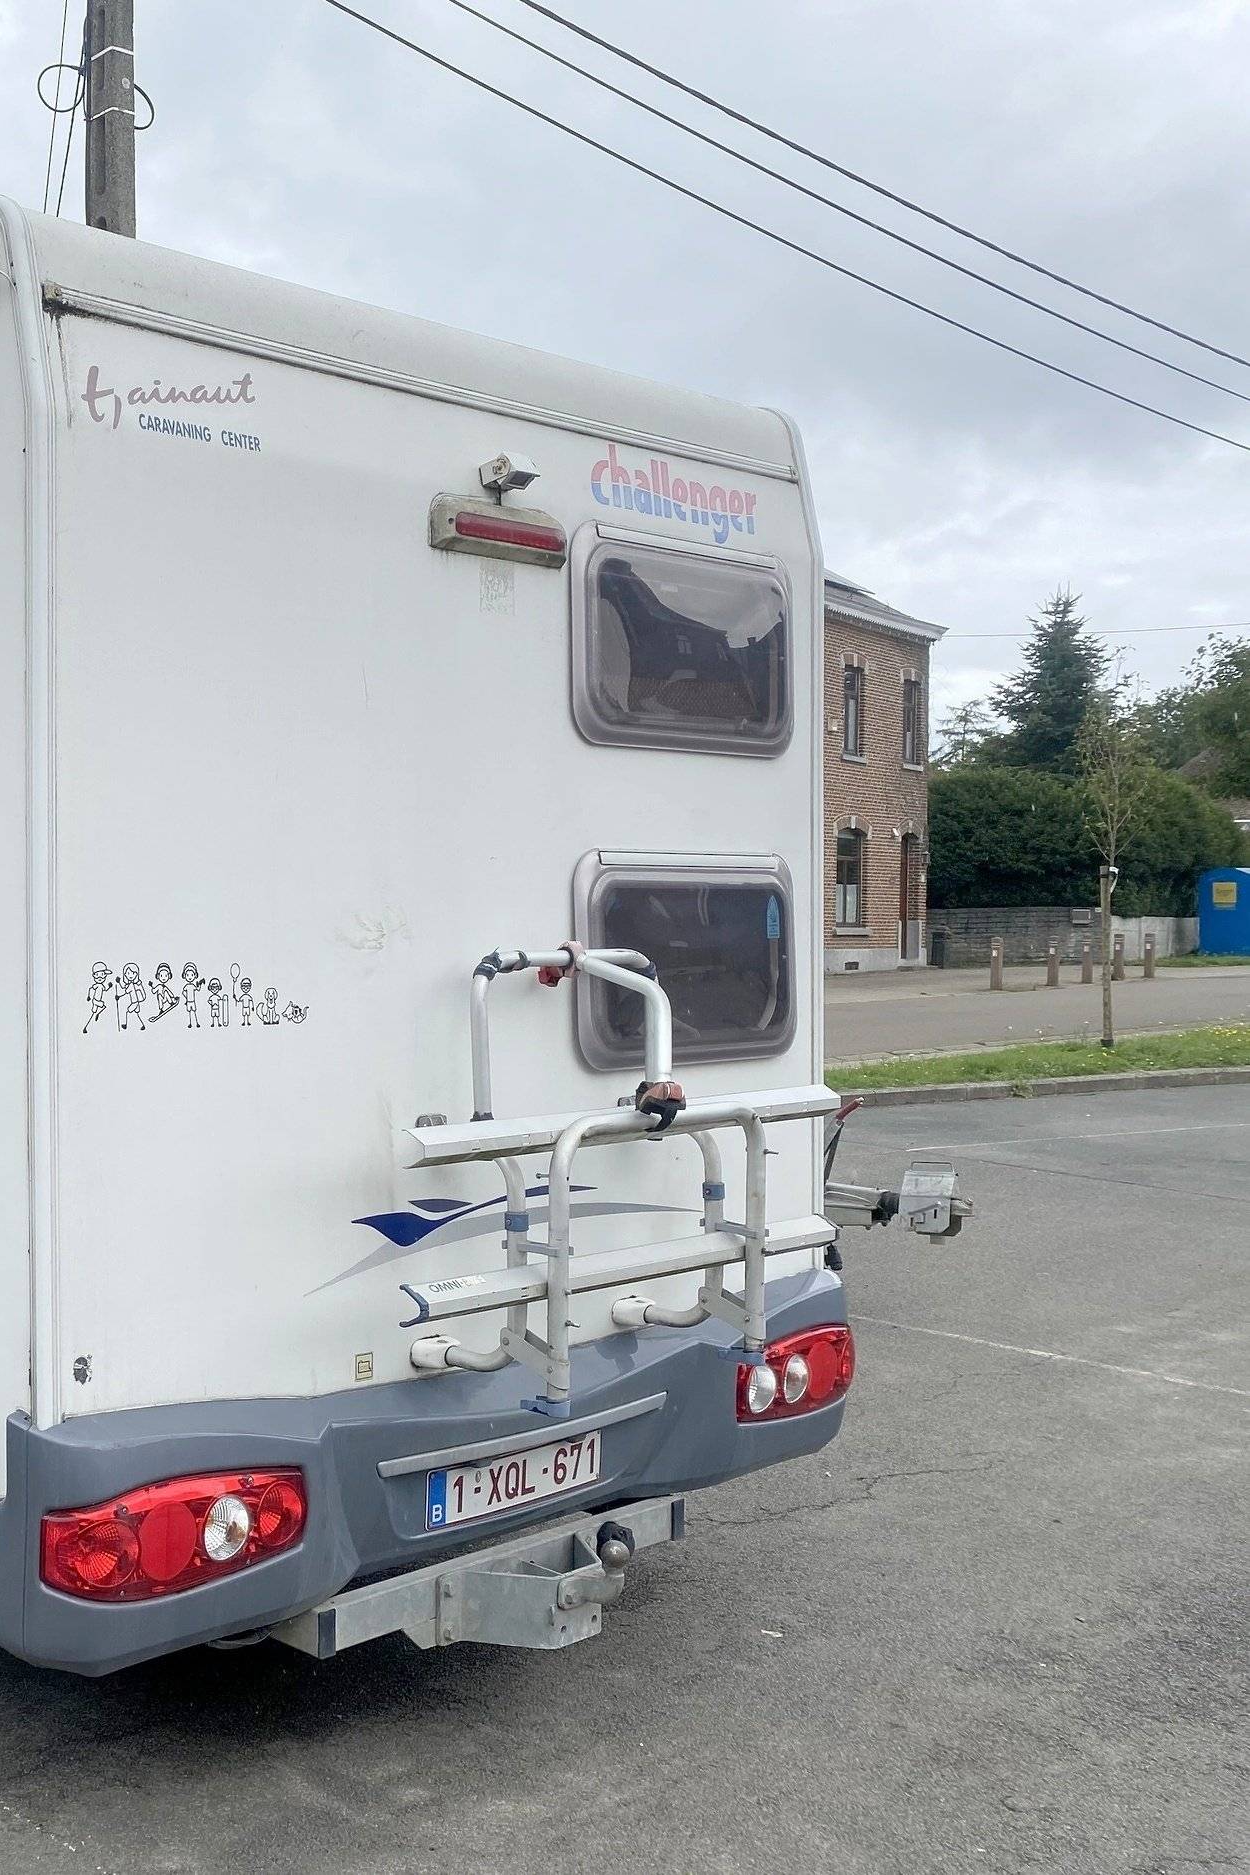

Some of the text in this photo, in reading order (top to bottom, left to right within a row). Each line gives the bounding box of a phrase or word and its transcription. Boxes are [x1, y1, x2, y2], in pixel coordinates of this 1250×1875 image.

[138, 413, 262, 452] CARAVANING CENTER
[590, 443, 758, 545] challenger
[431, 1503, 443, 1523] B
